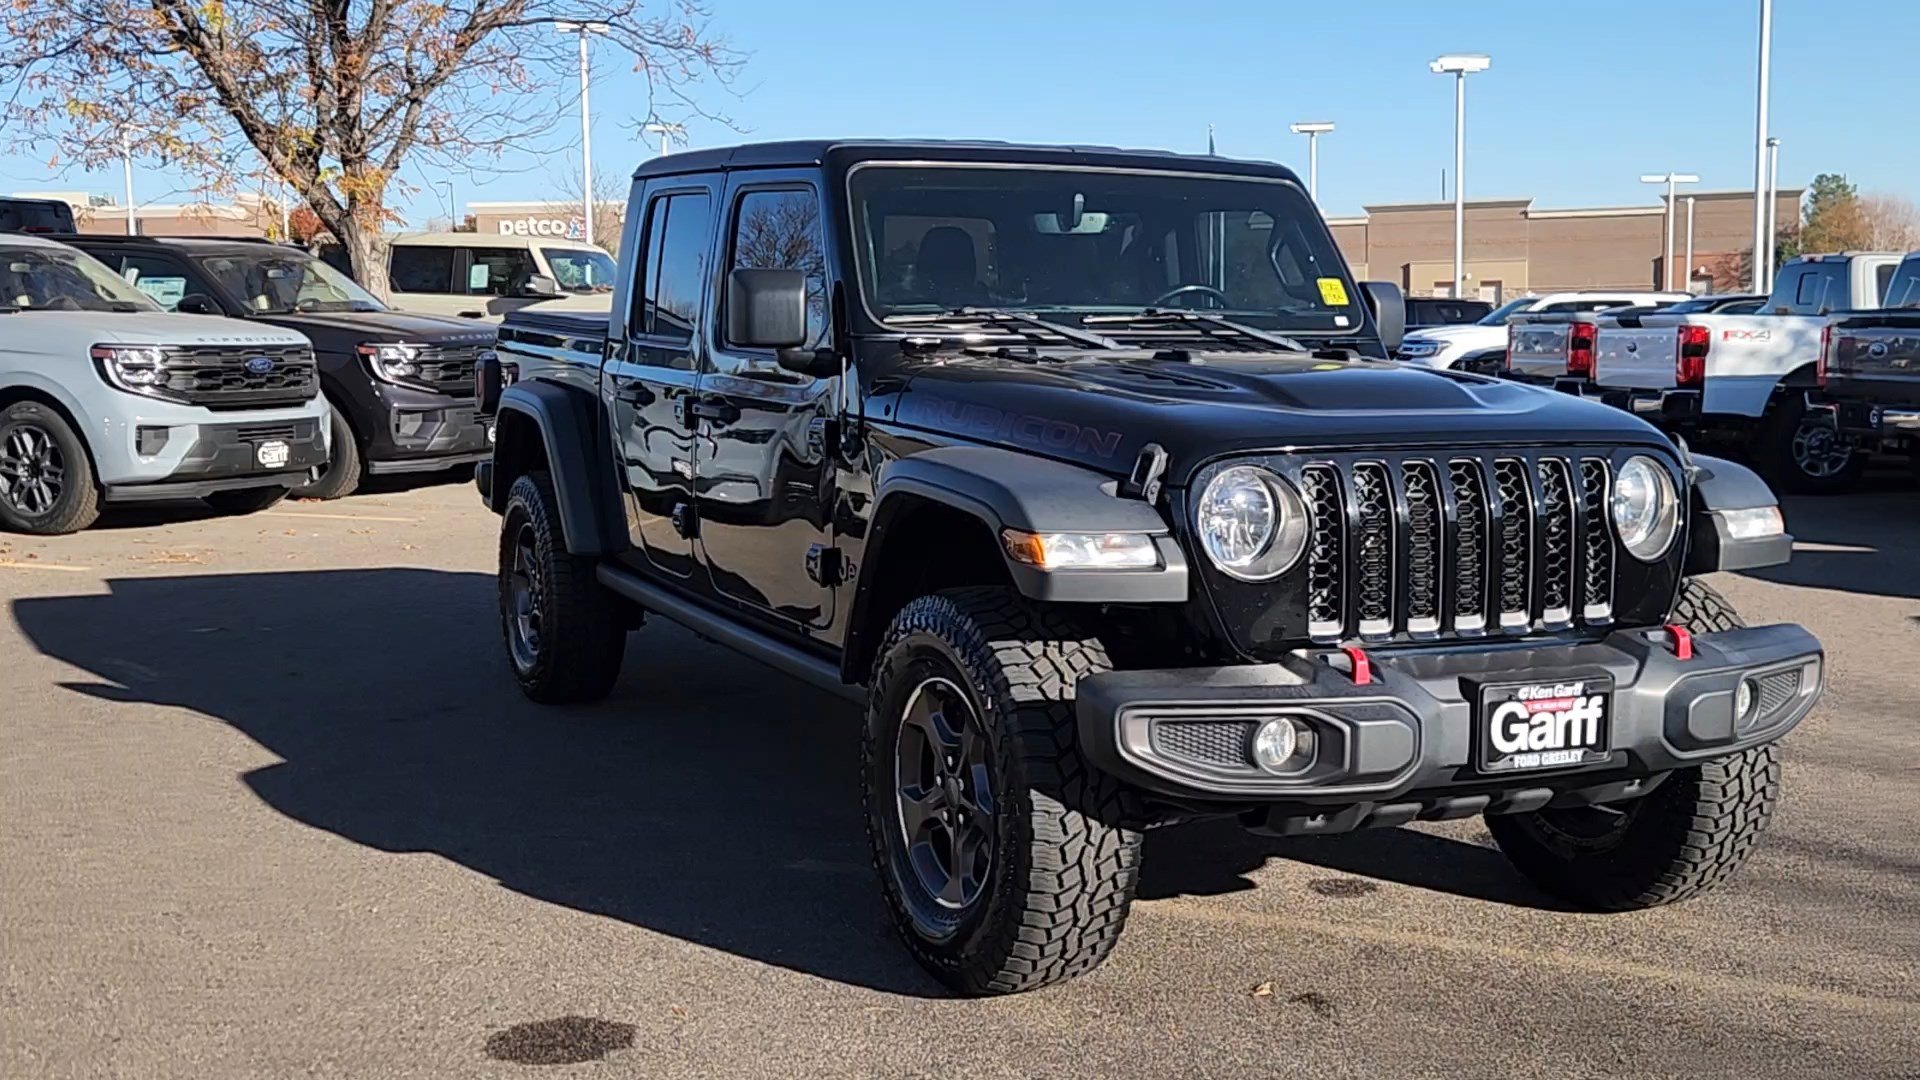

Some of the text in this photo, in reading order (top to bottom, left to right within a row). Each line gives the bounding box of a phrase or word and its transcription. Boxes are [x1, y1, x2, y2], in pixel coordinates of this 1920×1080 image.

[498, 216, 567, 236] petco
[1723, 329, 1771, 341] FX4
[911, 396, 1123, 459] RUBICON
[1529, 682, 1584, 700] Ken Garff
[1491, 696, 1603, 753] Garff
[1514, 750, 1584, 768] FORD GREELEY
